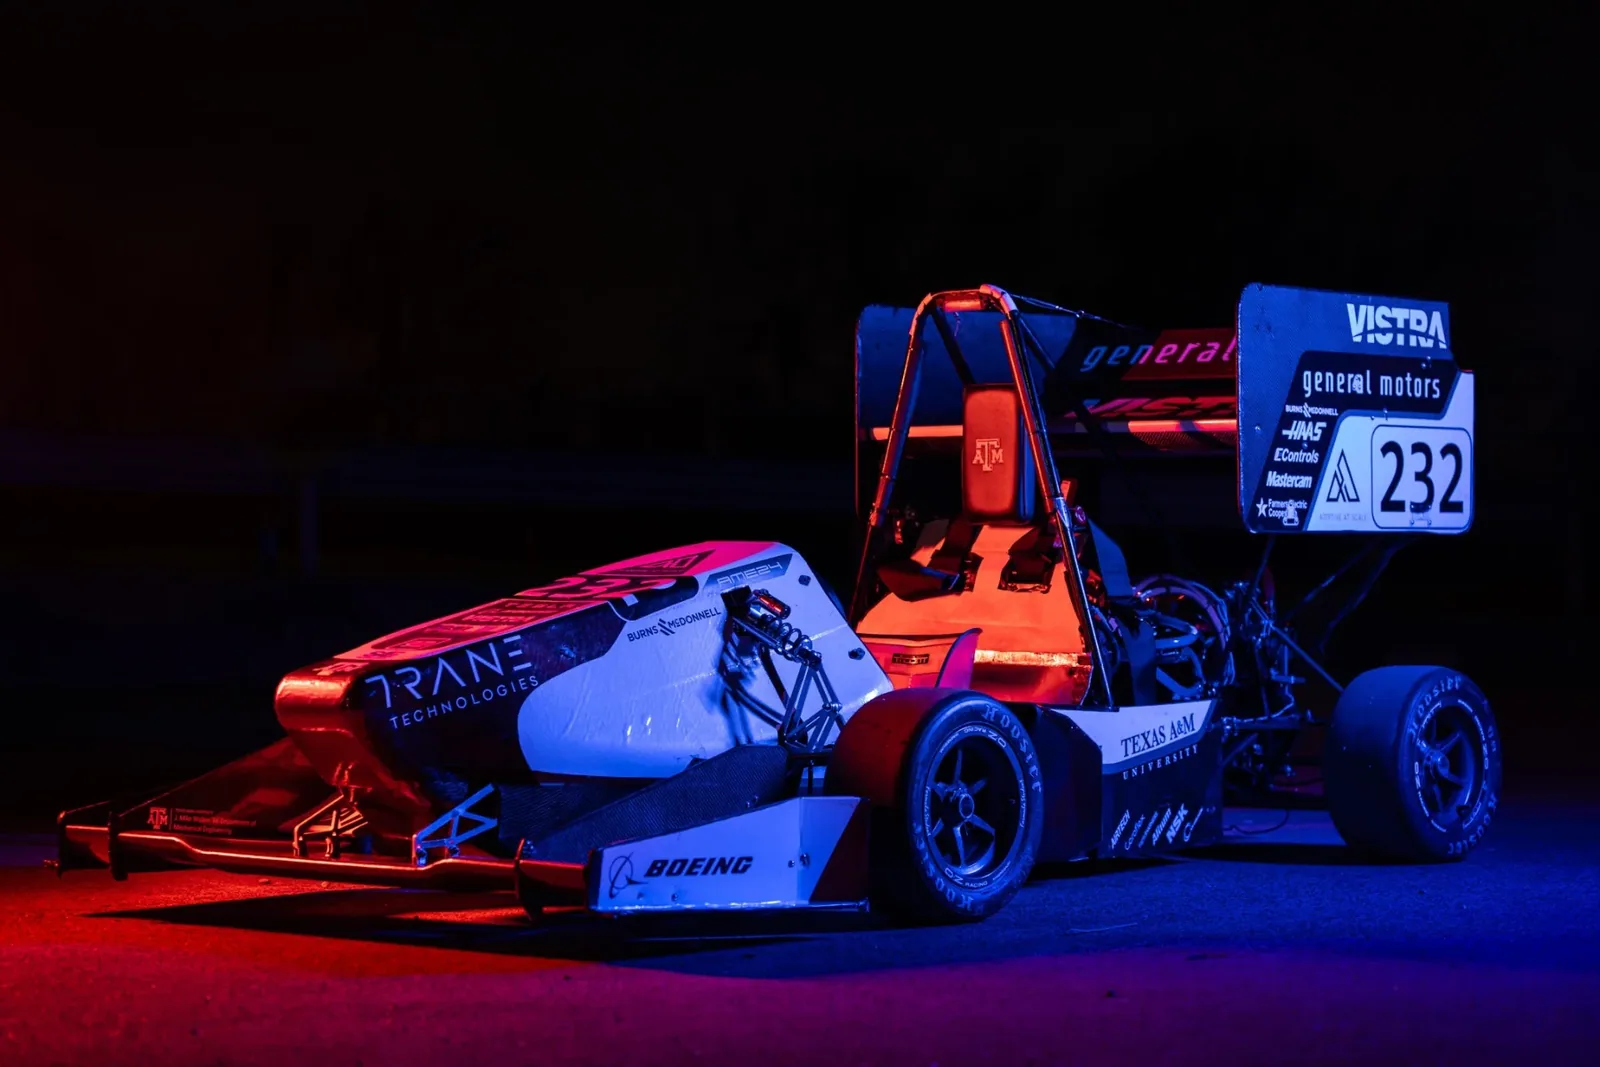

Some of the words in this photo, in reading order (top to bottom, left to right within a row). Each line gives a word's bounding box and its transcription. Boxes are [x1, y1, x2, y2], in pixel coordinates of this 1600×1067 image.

[1347, 303, 1447, 349] VISTRA
[1079, 341, 1238, 372] general
[1302, 369, 1372, 398] general
[1379, 373, 1441, 399] motors
[1281, 420, 1327, 442] HAAS
[1273, 447, 1320, 464] EControls
[1266, 470, 1313, 488] Mastercam
[1380, 440, 1464, 513] 232
[627, 625, 659, 642] BURNS
[364, 634, 533, 709] TRANE
[389, 675, 539, 730] TECHNOLOGIES
[1121, 726, 1166, 757] TEXAS
[1169, 713, 1195, 741] A&M
[1122, 744, 1199, 780] UNIVERSITY
[1166, 803, 1189, 844] NSK
[644, 857, 753, 877] BOEING
